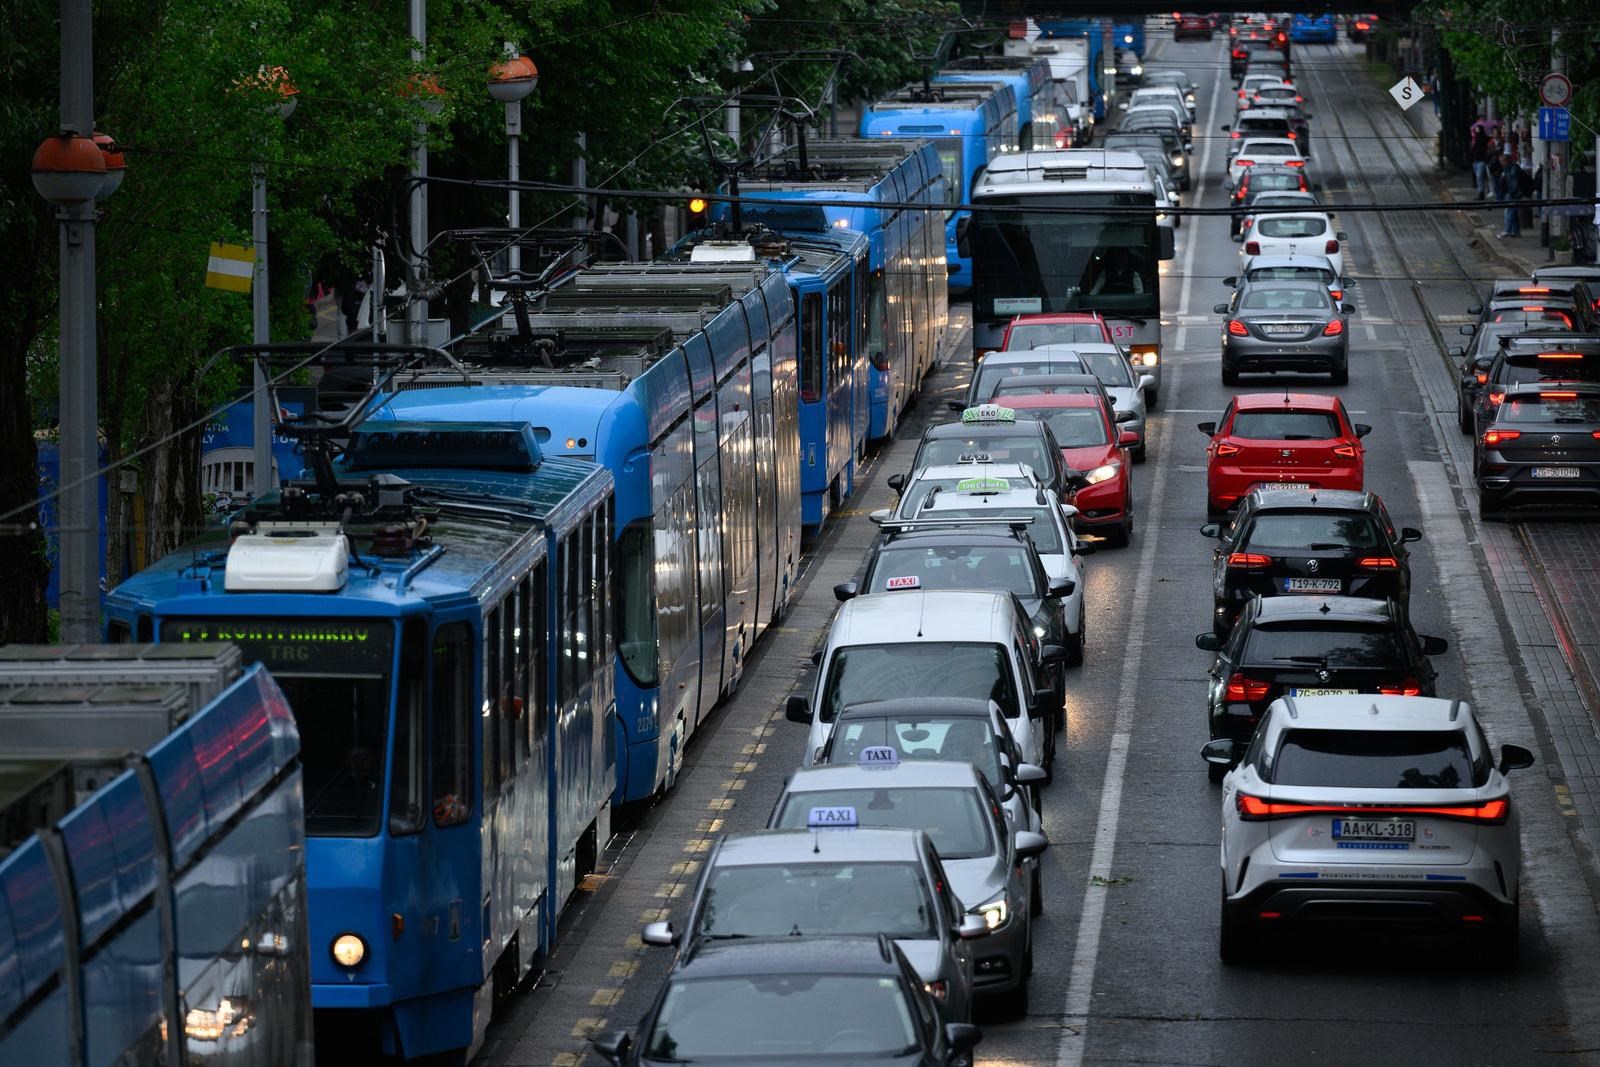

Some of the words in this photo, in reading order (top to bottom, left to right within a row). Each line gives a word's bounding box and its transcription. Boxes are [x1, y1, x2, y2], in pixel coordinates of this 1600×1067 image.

[1402, 86, 1412, 100] S
[891, 578, 915, 586] TAXI
[269, 646, 309, 660] TRG
[865, 750, 892, 760] TAXI
[816, 810, 851, 821] TAXI
